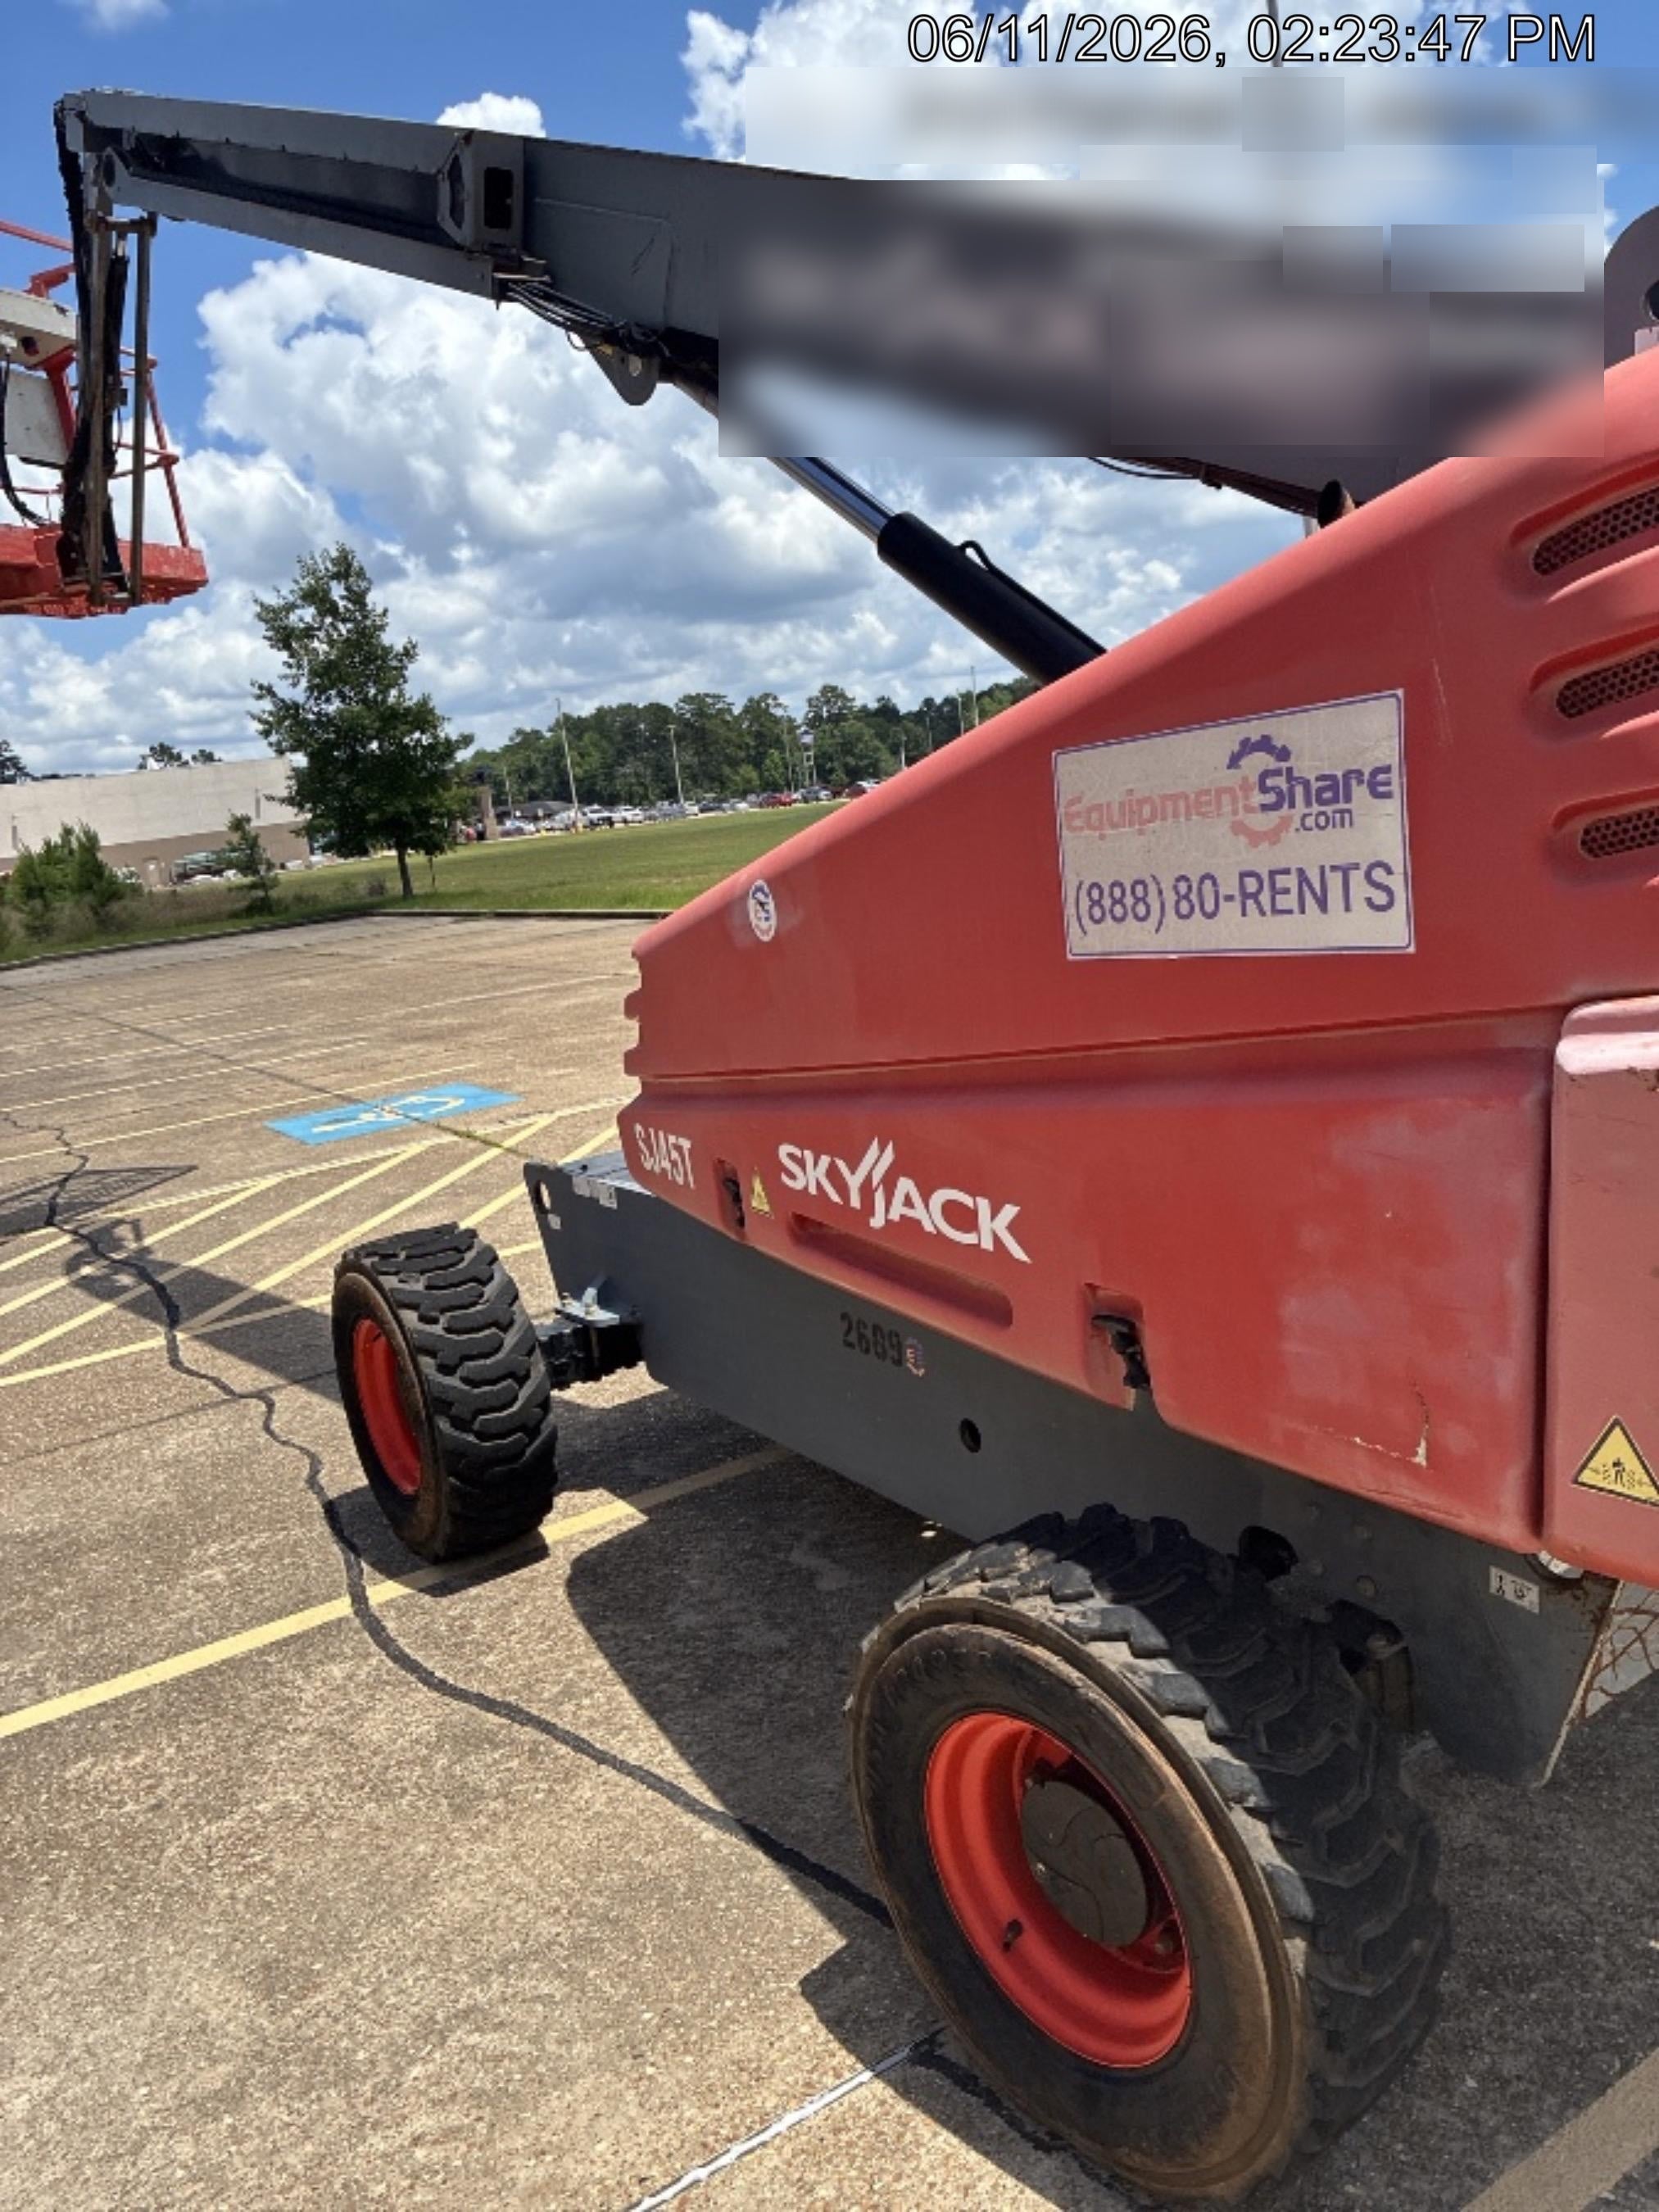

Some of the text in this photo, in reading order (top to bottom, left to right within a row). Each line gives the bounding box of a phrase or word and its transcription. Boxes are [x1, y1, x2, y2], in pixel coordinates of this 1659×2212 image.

[1294, 809, 1353, 832] .com
[634, 1123, 694, 1188] SJ45T
[778, 1136, 1031, 1263] SKYJACK
